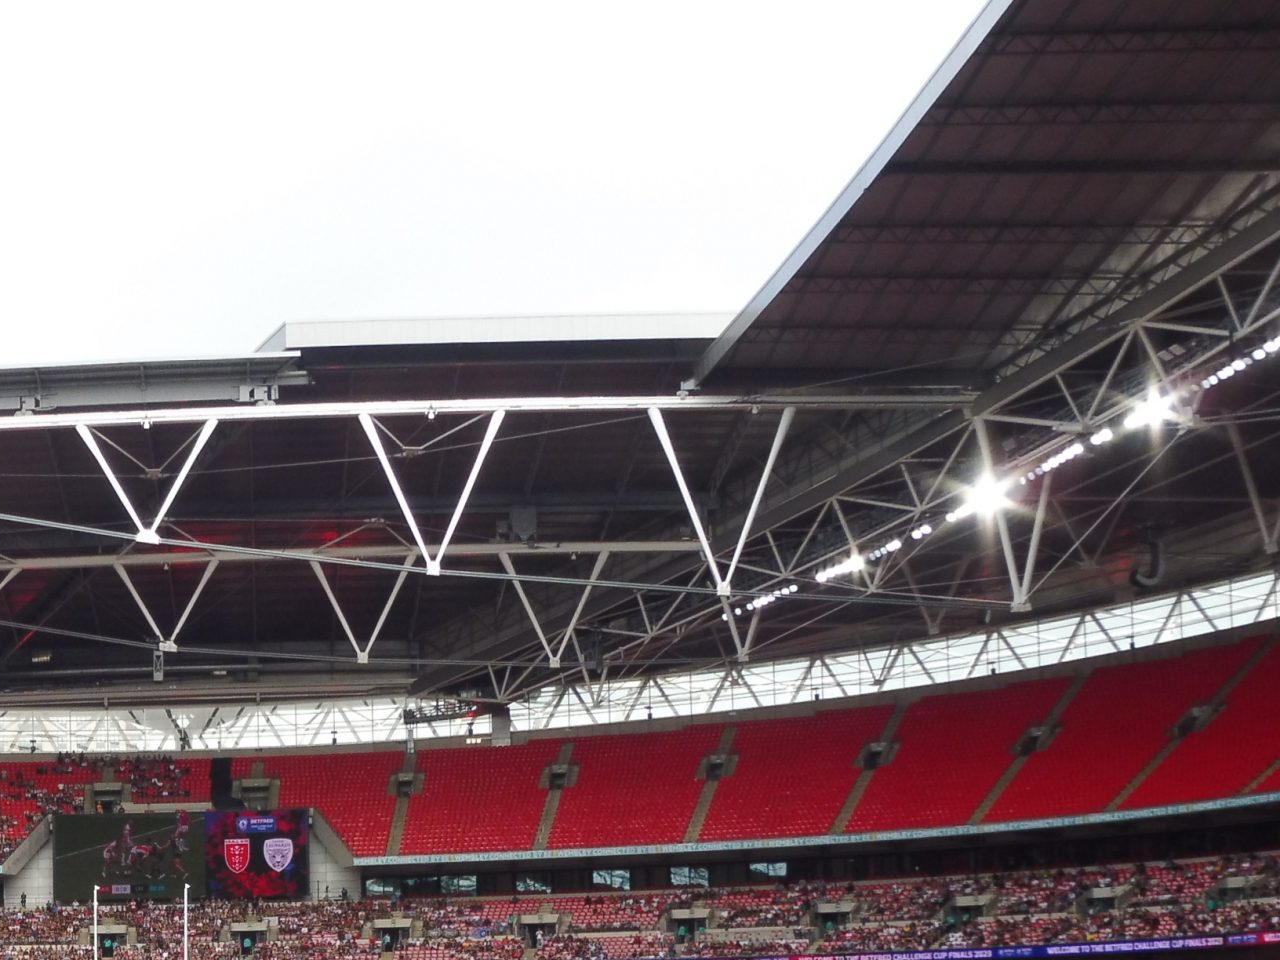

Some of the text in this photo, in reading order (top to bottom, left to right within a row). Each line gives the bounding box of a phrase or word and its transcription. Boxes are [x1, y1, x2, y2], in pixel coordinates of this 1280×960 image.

[893, 953, 931, 960] CHALLENGE
[949, 951, 973, 959] FINALS
[975, 950, 991, 958] 2023
